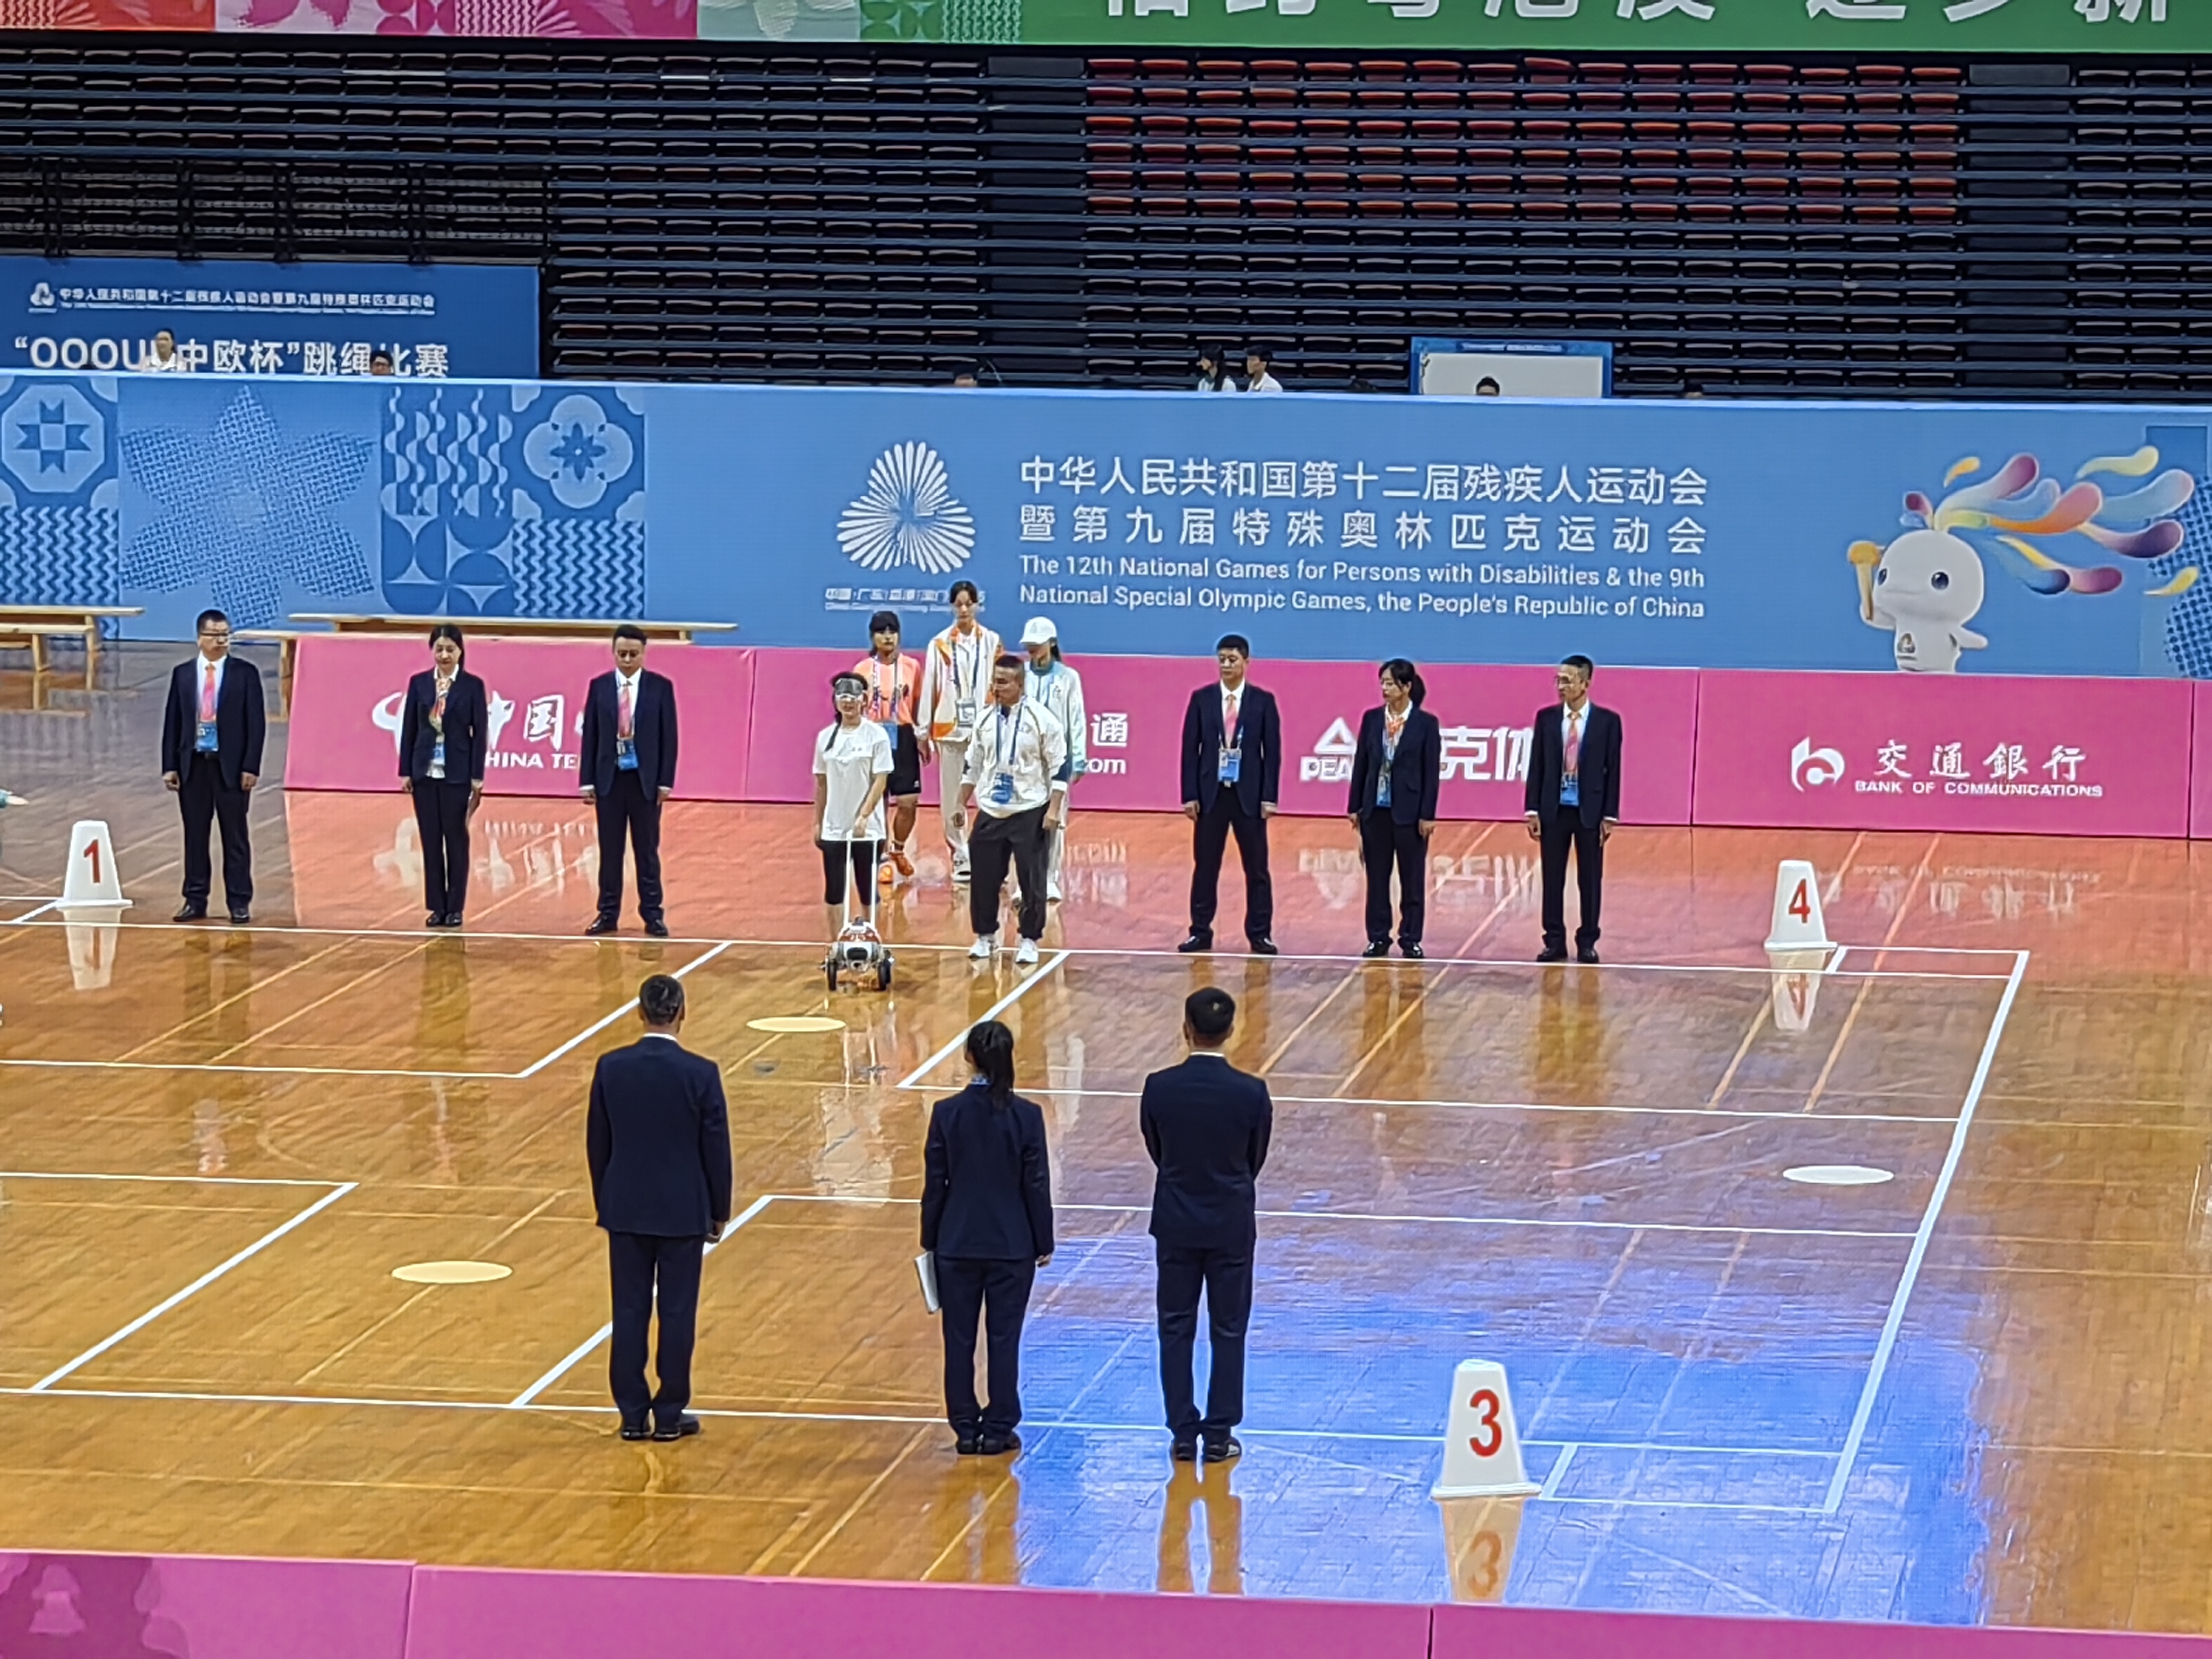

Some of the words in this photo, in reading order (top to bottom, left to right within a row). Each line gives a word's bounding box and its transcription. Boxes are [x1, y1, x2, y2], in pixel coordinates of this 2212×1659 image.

[1021, 455, 1707, 505] 中华人民共和国第十二届残疾人运动会
[1020, 504, 1706, 554] 暨第九届特殊奥林匹克运动会
[1020, 555, 1059, 575] The
[1066, 556, 1112, 576] 12th
[1120, 557, 1209, 577] National
[1216, 559, 1290, 579] Games
[1297, 559, 1327, 579] for
[1333, 561, 1421, 582] Persons
[1427, 563, 1473, 583] with
[1480, 563, 1600, 585] Disabilities
[1606, 567, 1621, 586] &
[1628, 567, 1663, 587] the
[1670, 568, 1704, 588] 9th
[1020, 584, 1108, 604] National
[1114, 586, 1191, 610] Special
[1198, 588, 1286, 612] Olympic
[1292, 591, 1372, 613] Games,
[1378, 591, 1412, 612] the
[1514, 595, 1609, 618] Republic
[1614, 596, 1637, 616] of
[1643, 596, 1704, 617] China
[485, 751, 543, 770] HINA
[1299, 756, 1355, 782] PEA
[1854, 780, 1903, 794] BANK
[1912, 781, 1936, 794] OF
[1945, 783, 2103, 797] COMMUNICATIONS
[83, 839, 101, 884] 1
[1788, 878, 1811, 924] 4
[1469, 1388, 1503, 1458] 3
